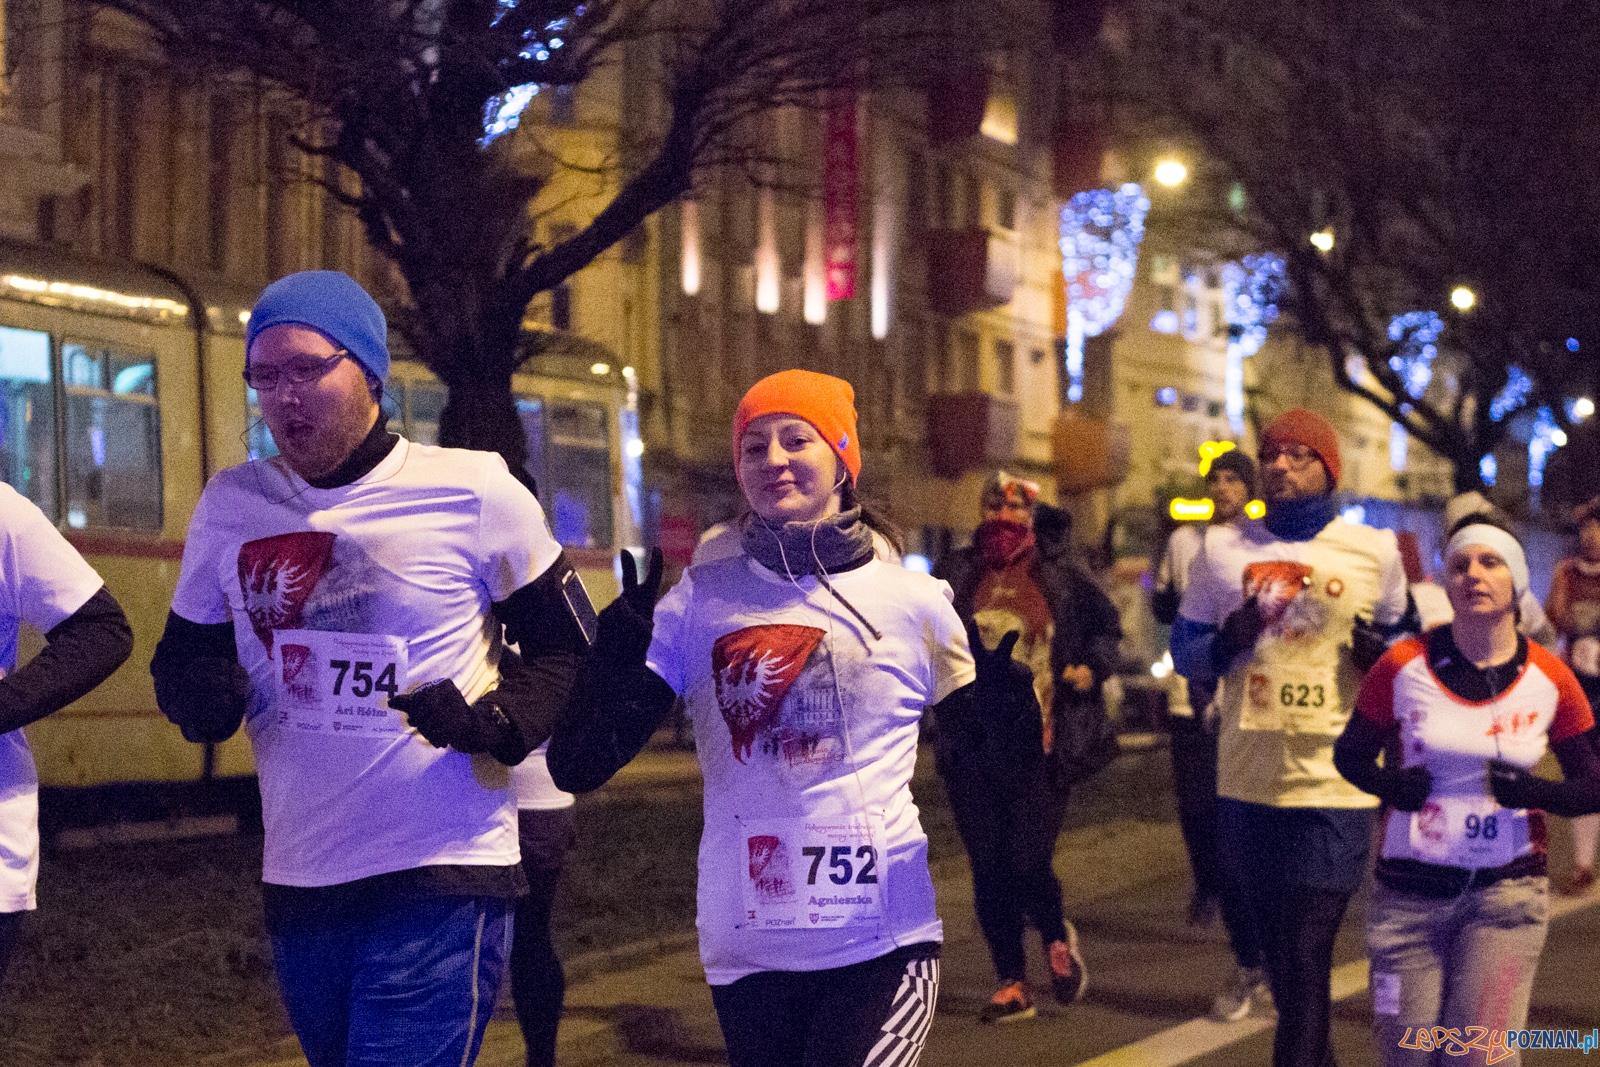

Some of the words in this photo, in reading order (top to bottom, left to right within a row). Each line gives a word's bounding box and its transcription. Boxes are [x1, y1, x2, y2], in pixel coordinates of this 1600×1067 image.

[330, 659, 398, 700] 754
[1280, 683, 1325, 707] 623
[1464, 813, 1498, 840] 98
[802, 845, 879, 885] 752
[807, 895, 873, 907] Agnieszka
